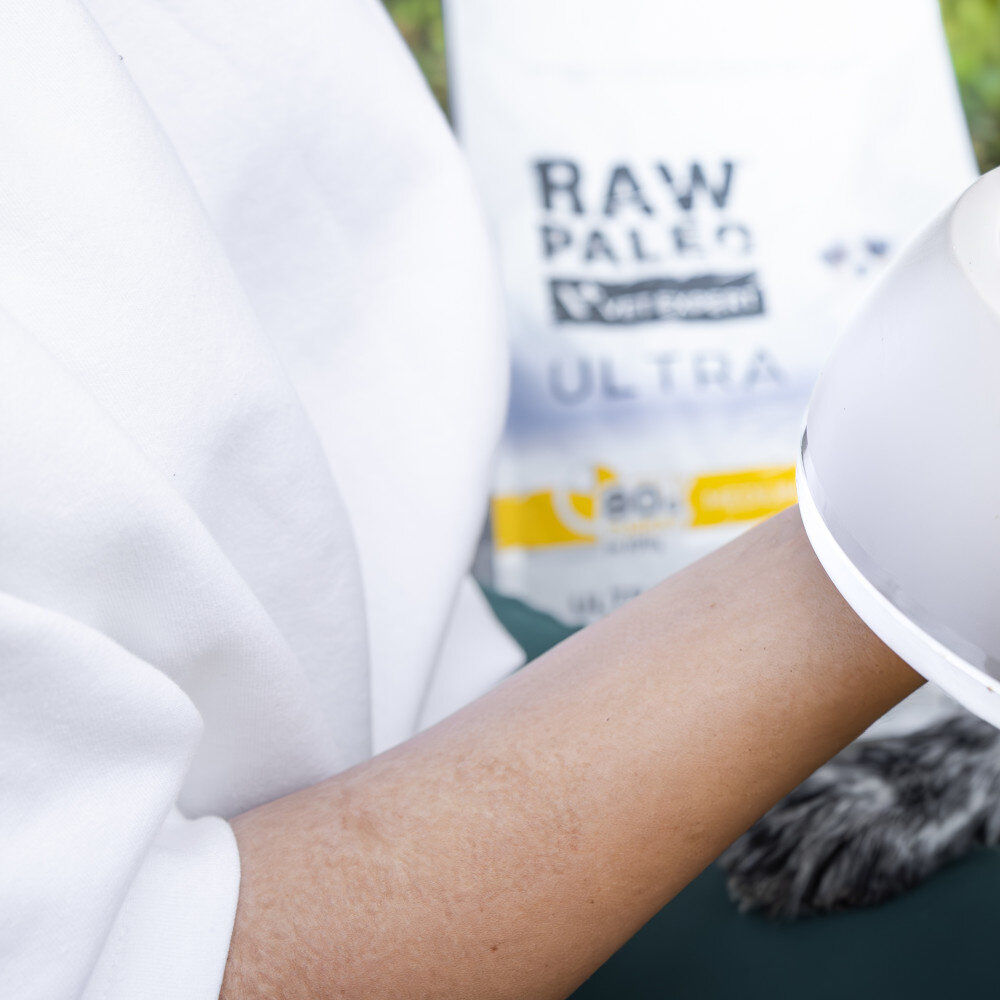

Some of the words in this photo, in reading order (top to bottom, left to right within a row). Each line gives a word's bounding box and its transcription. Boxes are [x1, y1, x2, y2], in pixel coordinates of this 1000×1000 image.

[535, 158, 735, 218] RAW
[541, 222, 754, 264] PALEO
[550, 347, 789, 404] ULTRA
